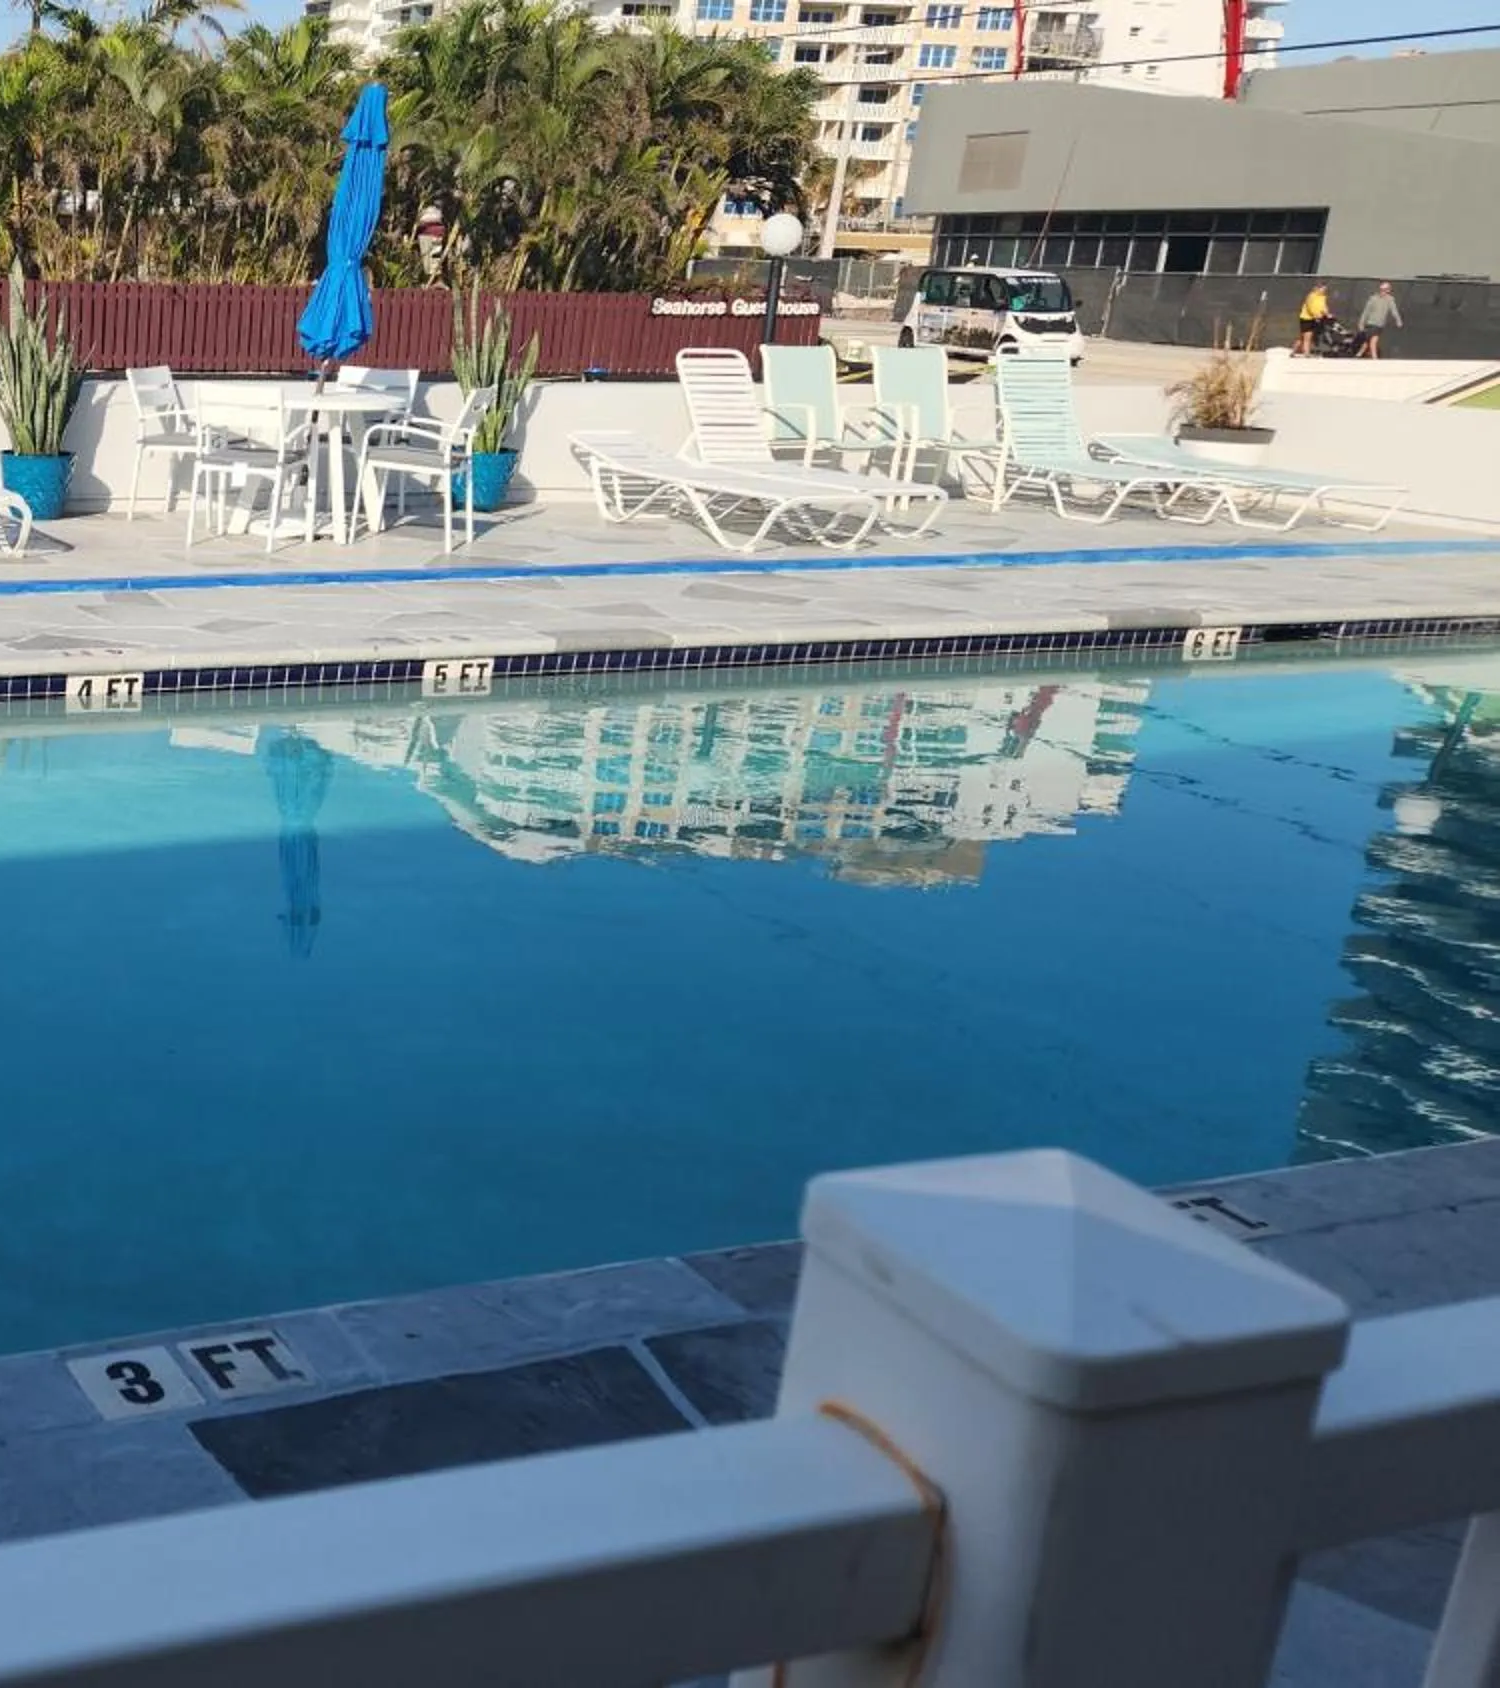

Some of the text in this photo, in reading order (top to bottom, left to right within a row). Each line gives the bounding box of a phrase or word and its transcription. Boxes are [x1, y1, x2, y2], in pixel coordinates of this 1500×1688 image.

[651, 297, 820, 316] Seahorse Gueshouse
[1212, 631, 1237, 648] FT
[435, 662, 488, 681] 5 FT
[78, 677, 139, 698] 4 FT
[105, 1360, 165, 1405] 3
